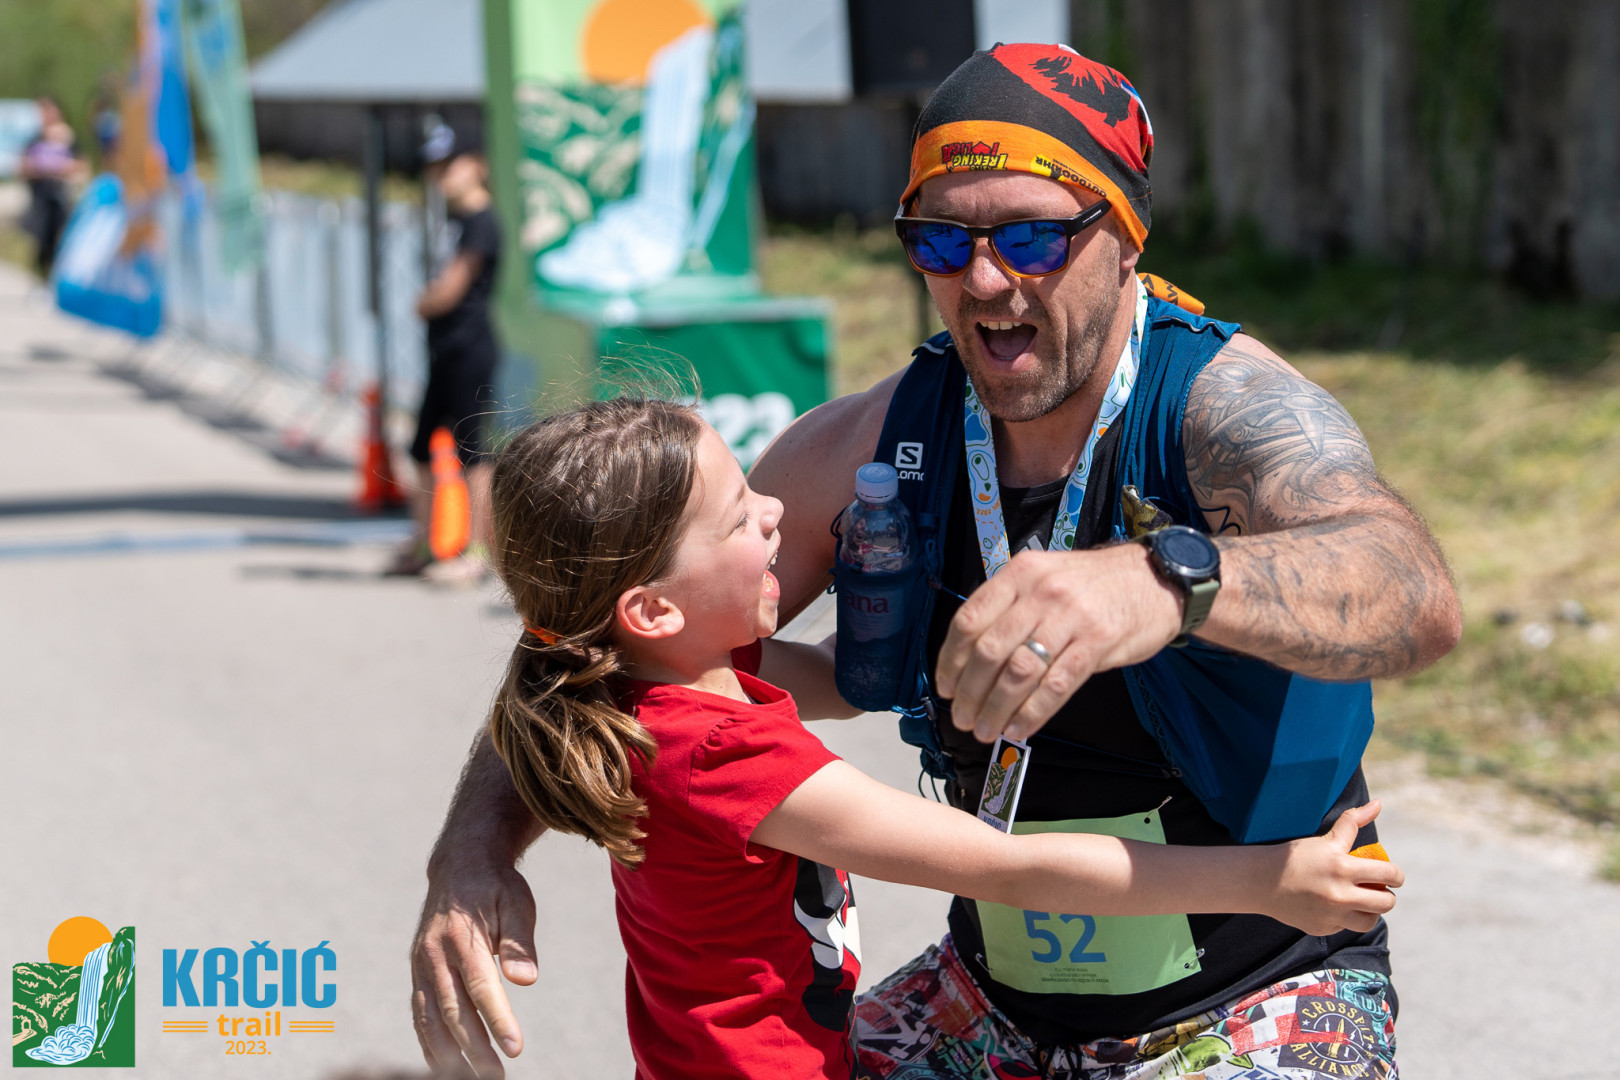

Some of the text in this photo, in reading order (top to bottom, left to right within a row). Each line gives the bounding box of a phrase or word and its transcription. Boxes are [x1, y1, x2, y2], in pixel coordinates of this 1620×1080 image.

[952, 153, 1009, 170] TREKING
[846, 590, 889, 613] ana
[1023, 909, 1107, 963] 52
[1302, 1001, 1375, 1044] CROSSFIT
[1290, 1043, 1370, 1077] ALLIANCE
